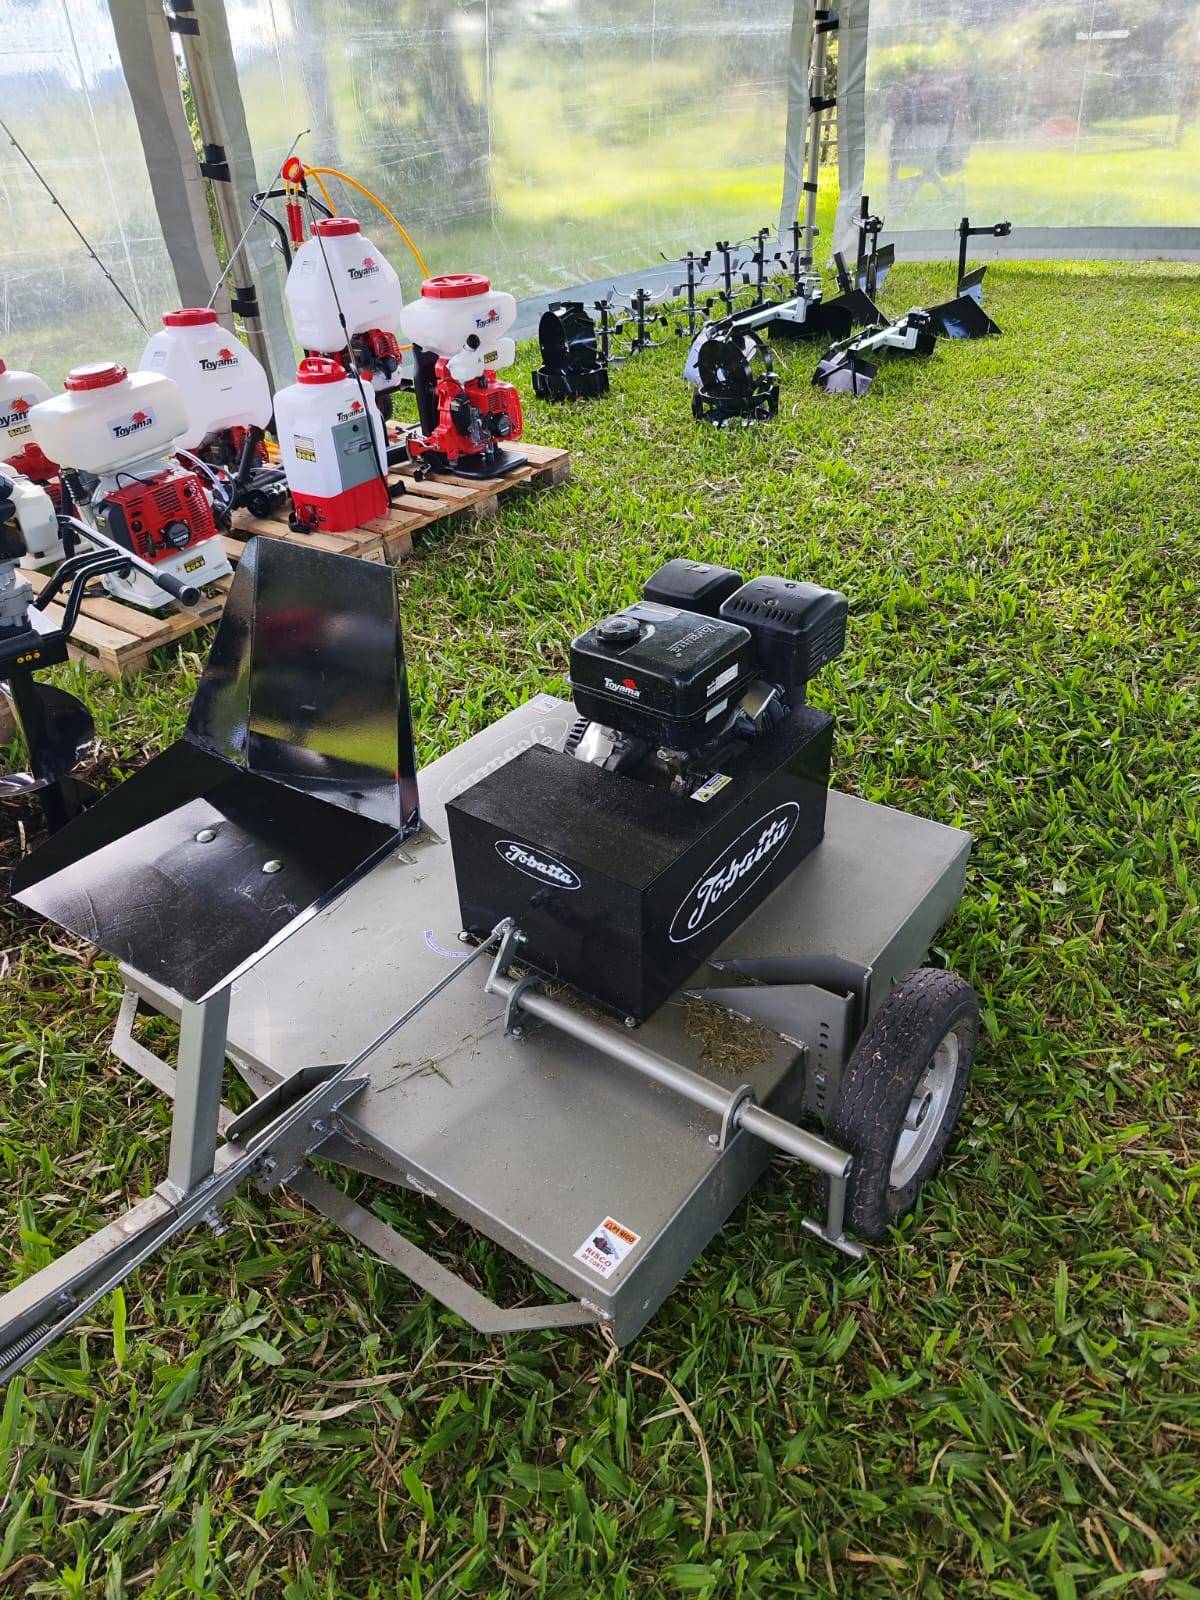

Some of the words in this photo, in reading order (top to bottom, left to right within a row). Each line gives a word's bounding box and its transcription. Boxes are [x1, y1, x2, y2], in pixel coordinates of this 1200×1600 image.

[347, 265, 380, 280] Toyama
[475, 315, 500, 329] Toyama
[199, 357, 239, 372] Toyama
[336, 407, 365, 422] Toyama
[112, 417, 153, 439] Toyama
[603, 677, 641, 699] Toyama
[505, 845, 573, 884] Tobatta
[687, 815, 789, 930] Tobatta
[585, 1247, 612, 1267] RISCO
[589, 1258, 607, 1272] CORTE
